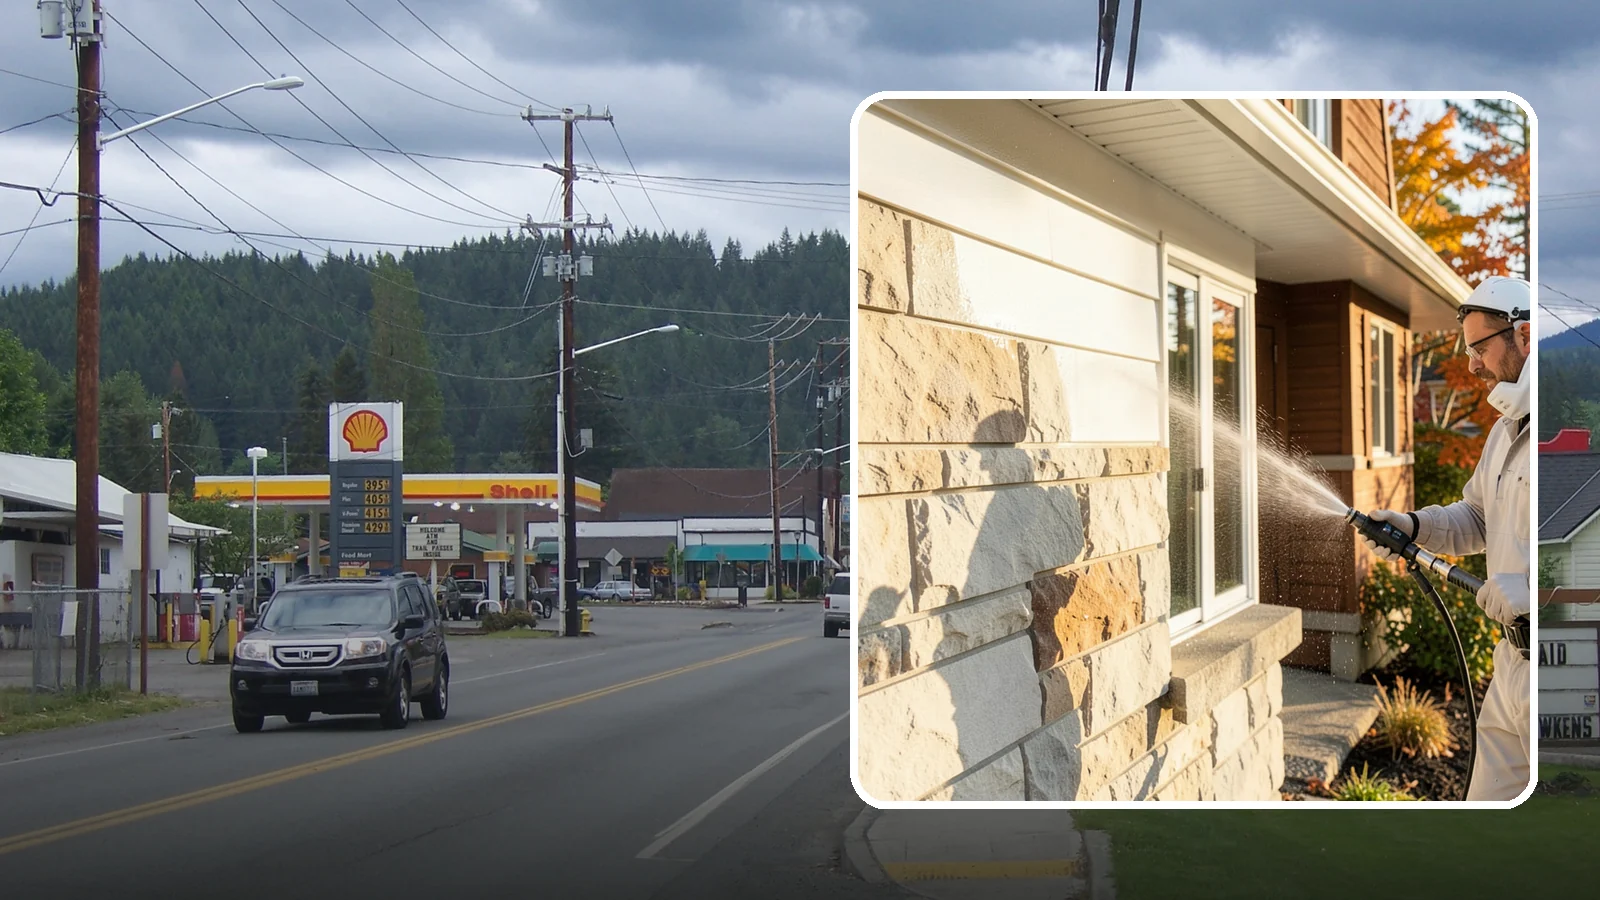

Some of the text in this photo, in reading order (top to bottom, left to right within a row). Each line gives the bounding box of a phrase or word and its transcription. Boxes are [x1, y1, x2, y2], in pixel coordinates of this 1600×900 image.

[366, 480, 383, 490] 395
[490, 484, 547, 498] Shell
[366, 494, 383, 504] 405
[365, 508, 383, 518] 415
[366, 522, 383, 532] 429
[1538, 643, 1567, 665] AID
